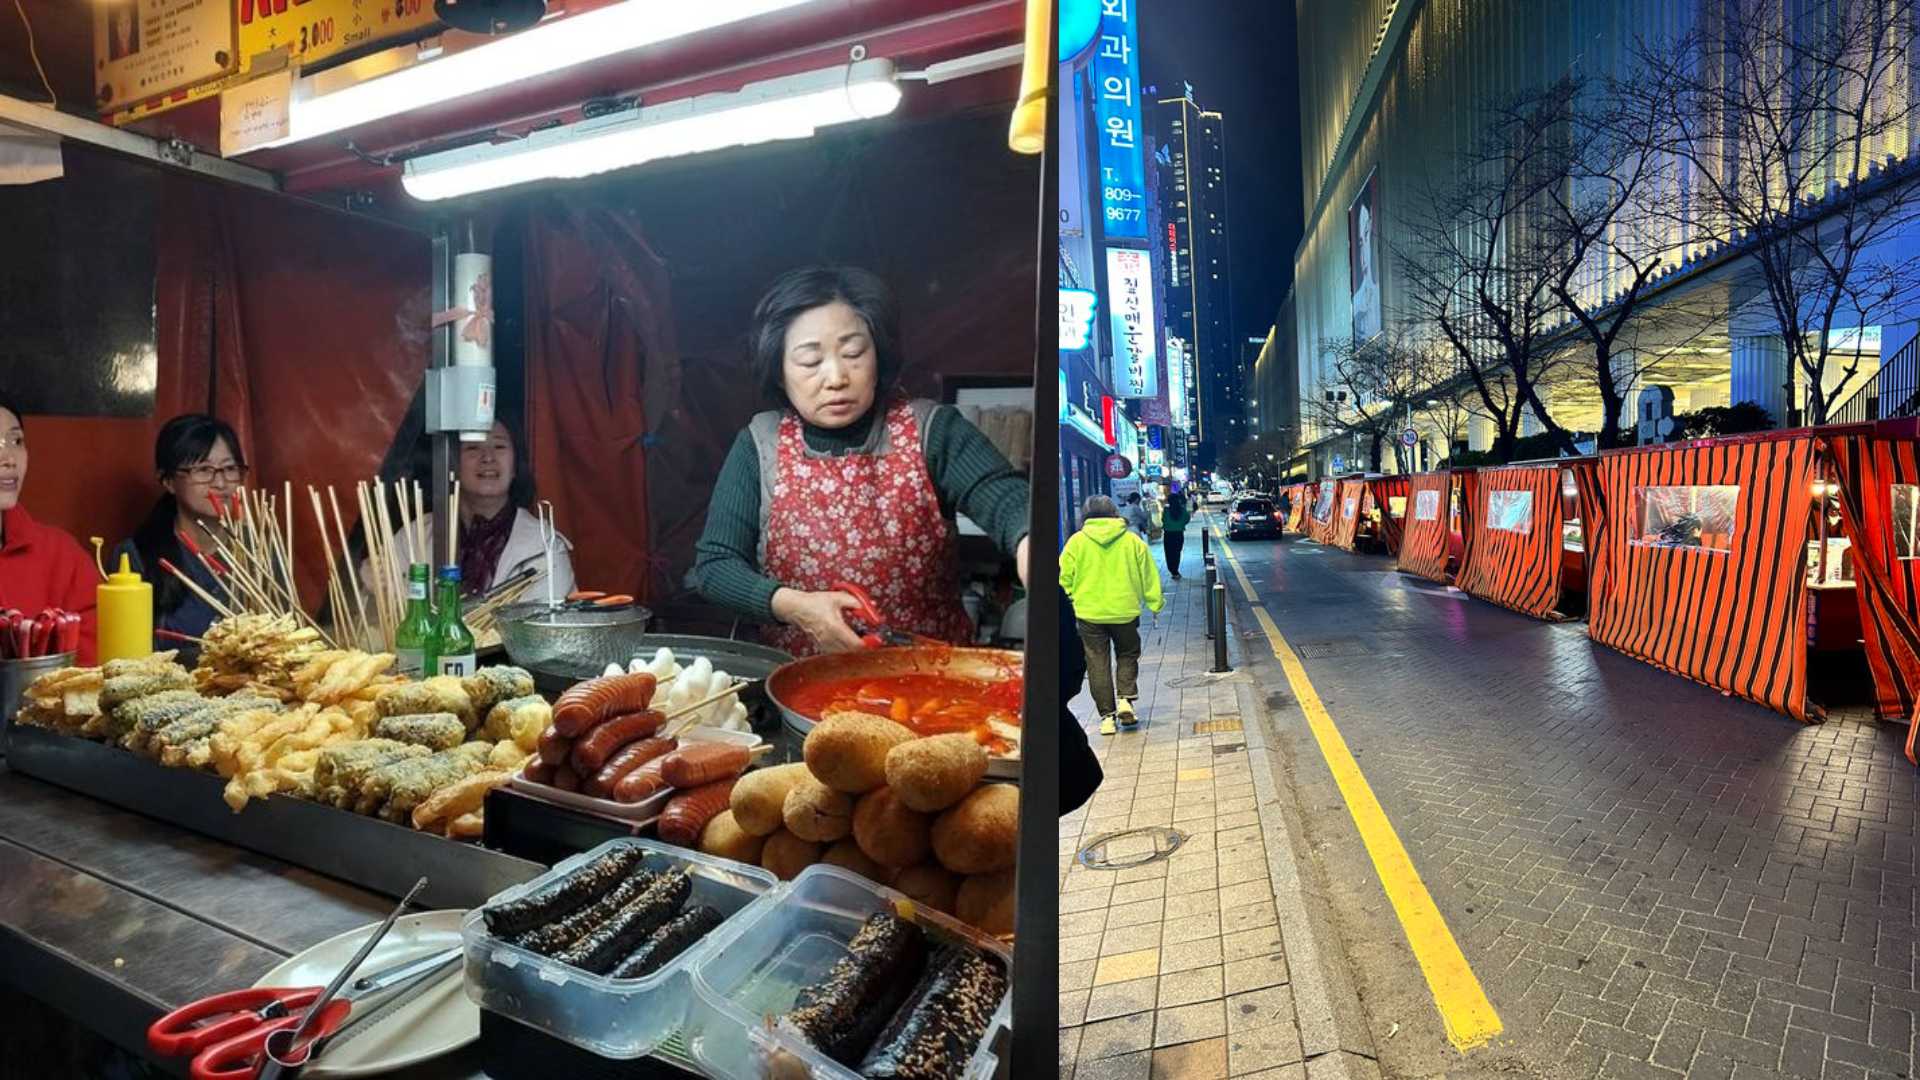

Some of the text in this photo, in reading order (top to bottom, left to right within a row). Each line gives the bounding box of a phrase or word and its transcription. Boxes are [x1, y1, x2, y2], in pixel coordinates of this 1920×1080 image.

[343, 28, 371, 45] Small
[1101, 0, 1135, 148] 외과의원
[1104, 167, 1119, 182] T.
[1104, 187, 1142, 201] 809-
[1106, 208, 1142, 222] 9677
